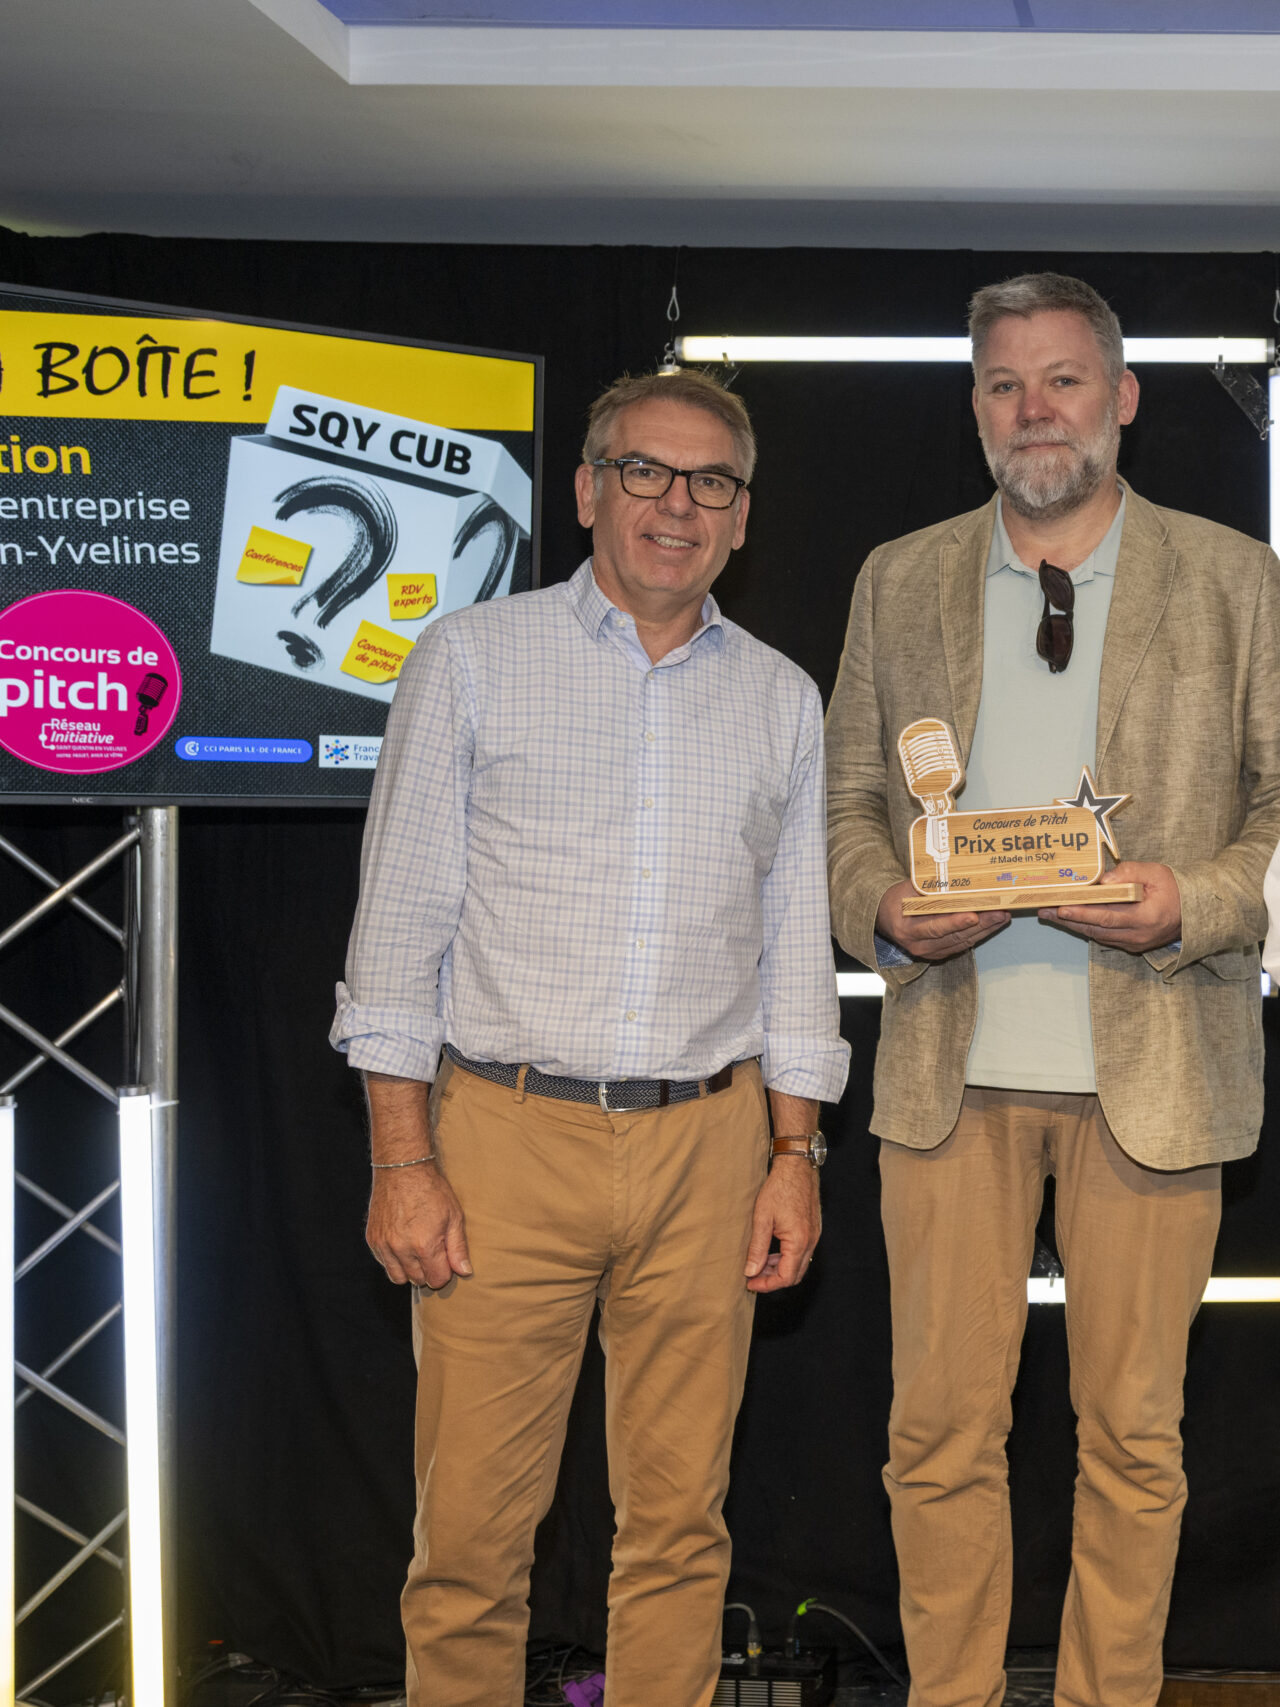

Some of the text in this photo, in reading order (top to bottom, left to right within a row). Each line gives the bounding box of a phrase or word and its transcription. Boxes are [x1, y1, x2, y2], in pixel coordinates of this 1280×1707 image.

[33, 333, 220, 401] BOÎTE
[242, 349, 256, 402] !
[289, 403, 473, 476] SQY CUB
[245, 548, 304, 573] Conférences
[400, 583, 425, 596] RDV
[393, 594, 433, 609] experts
[0, 639, 159, 667] Concours de
[357, 638, 404, 663] Concours
[354, 652, 397, 674] de pitch
[0, 669, 128, 717] pitch
[50, 718, 101, 732] Réseau
[50, 730, 114, 744] Initiative
[219, 745, 243, 753] PARIS
[353, 744, 380, 753] Franc
[354, 752, 379, 761] Trava
[972, 812, 1068, 831] Concours de Pitch
[954, 831, 1089, 855] Prix start-up
[1025, 854, 1033, 863] in
[1035, 852, 1056, 862] SQY
[922, 877, 971, 889] Edition 2026
